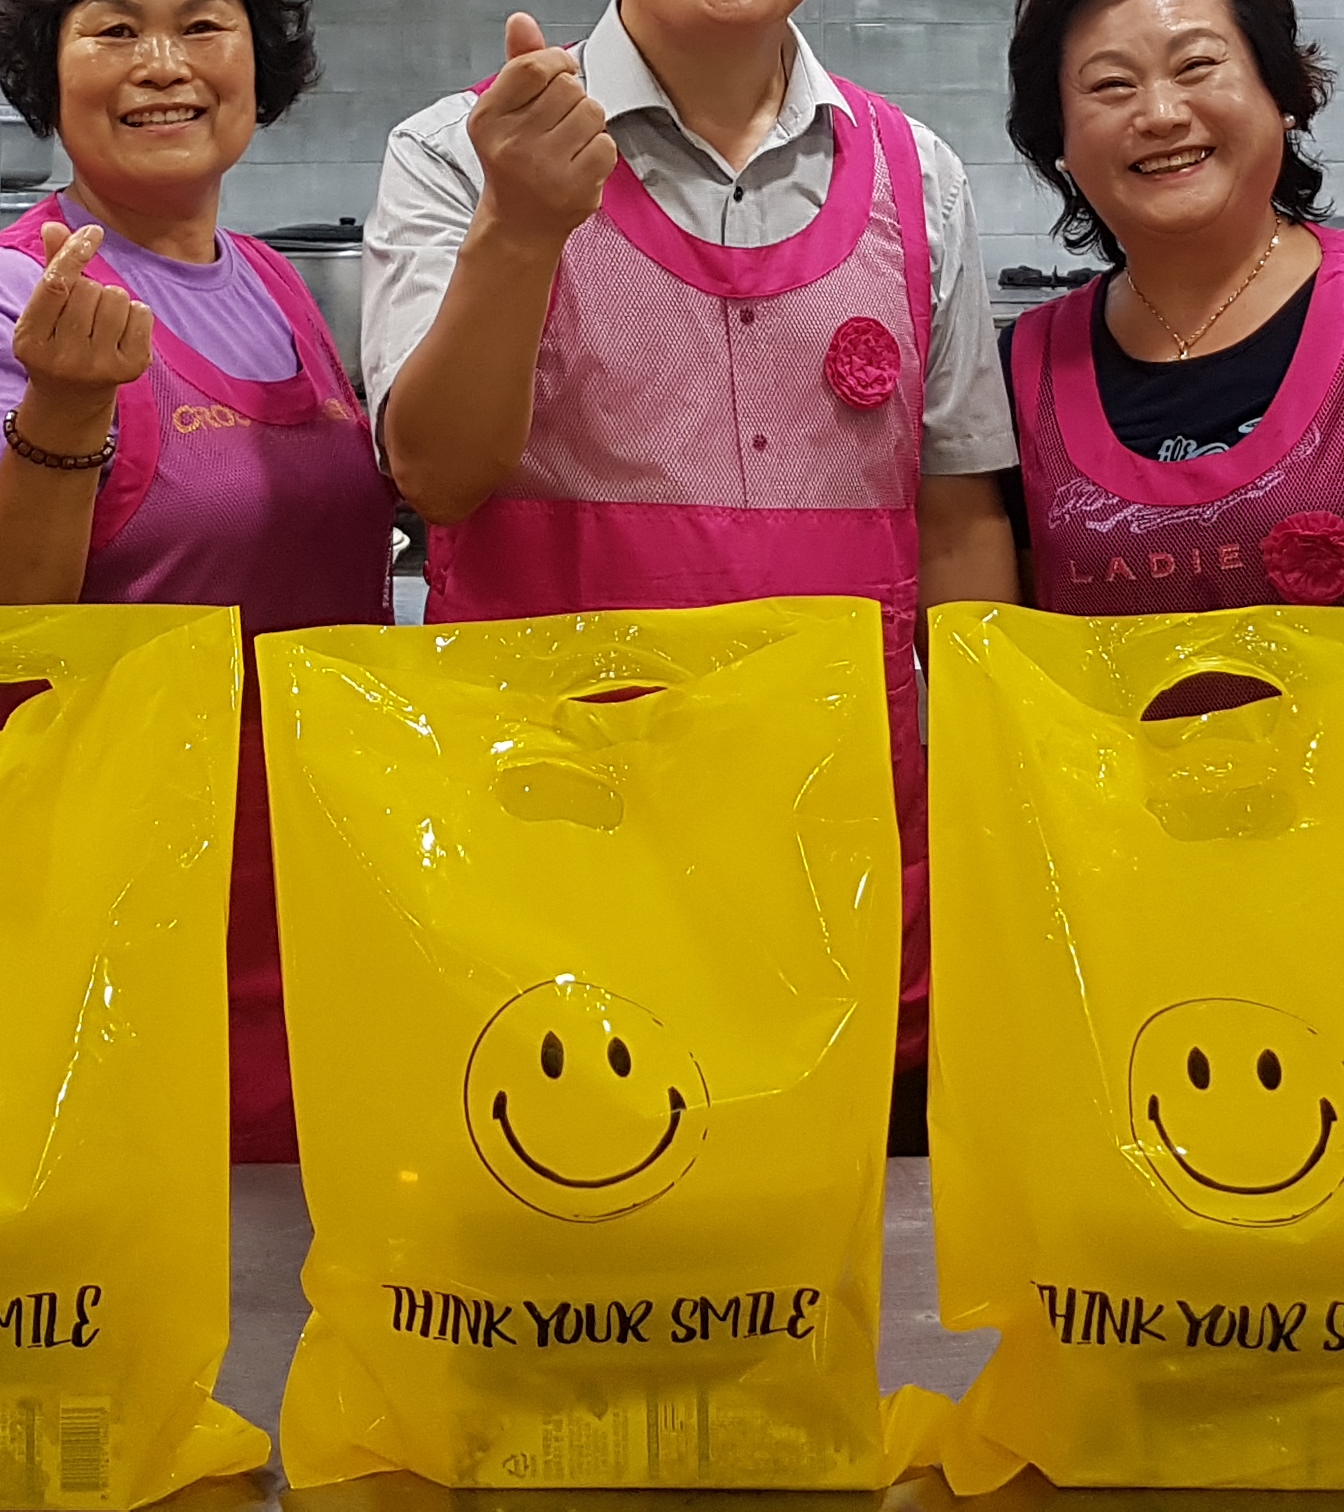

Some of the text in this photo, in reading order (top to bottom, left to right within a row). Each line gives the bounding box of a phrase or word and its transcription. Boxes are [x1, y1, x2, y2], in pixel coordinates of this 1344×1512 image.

[1069, 543, 1245, 584] LADIE
[382, 1285, 819, 1348] THINK YOUR SMILE
[1177, 1301, 1306, 1352] YOUR
